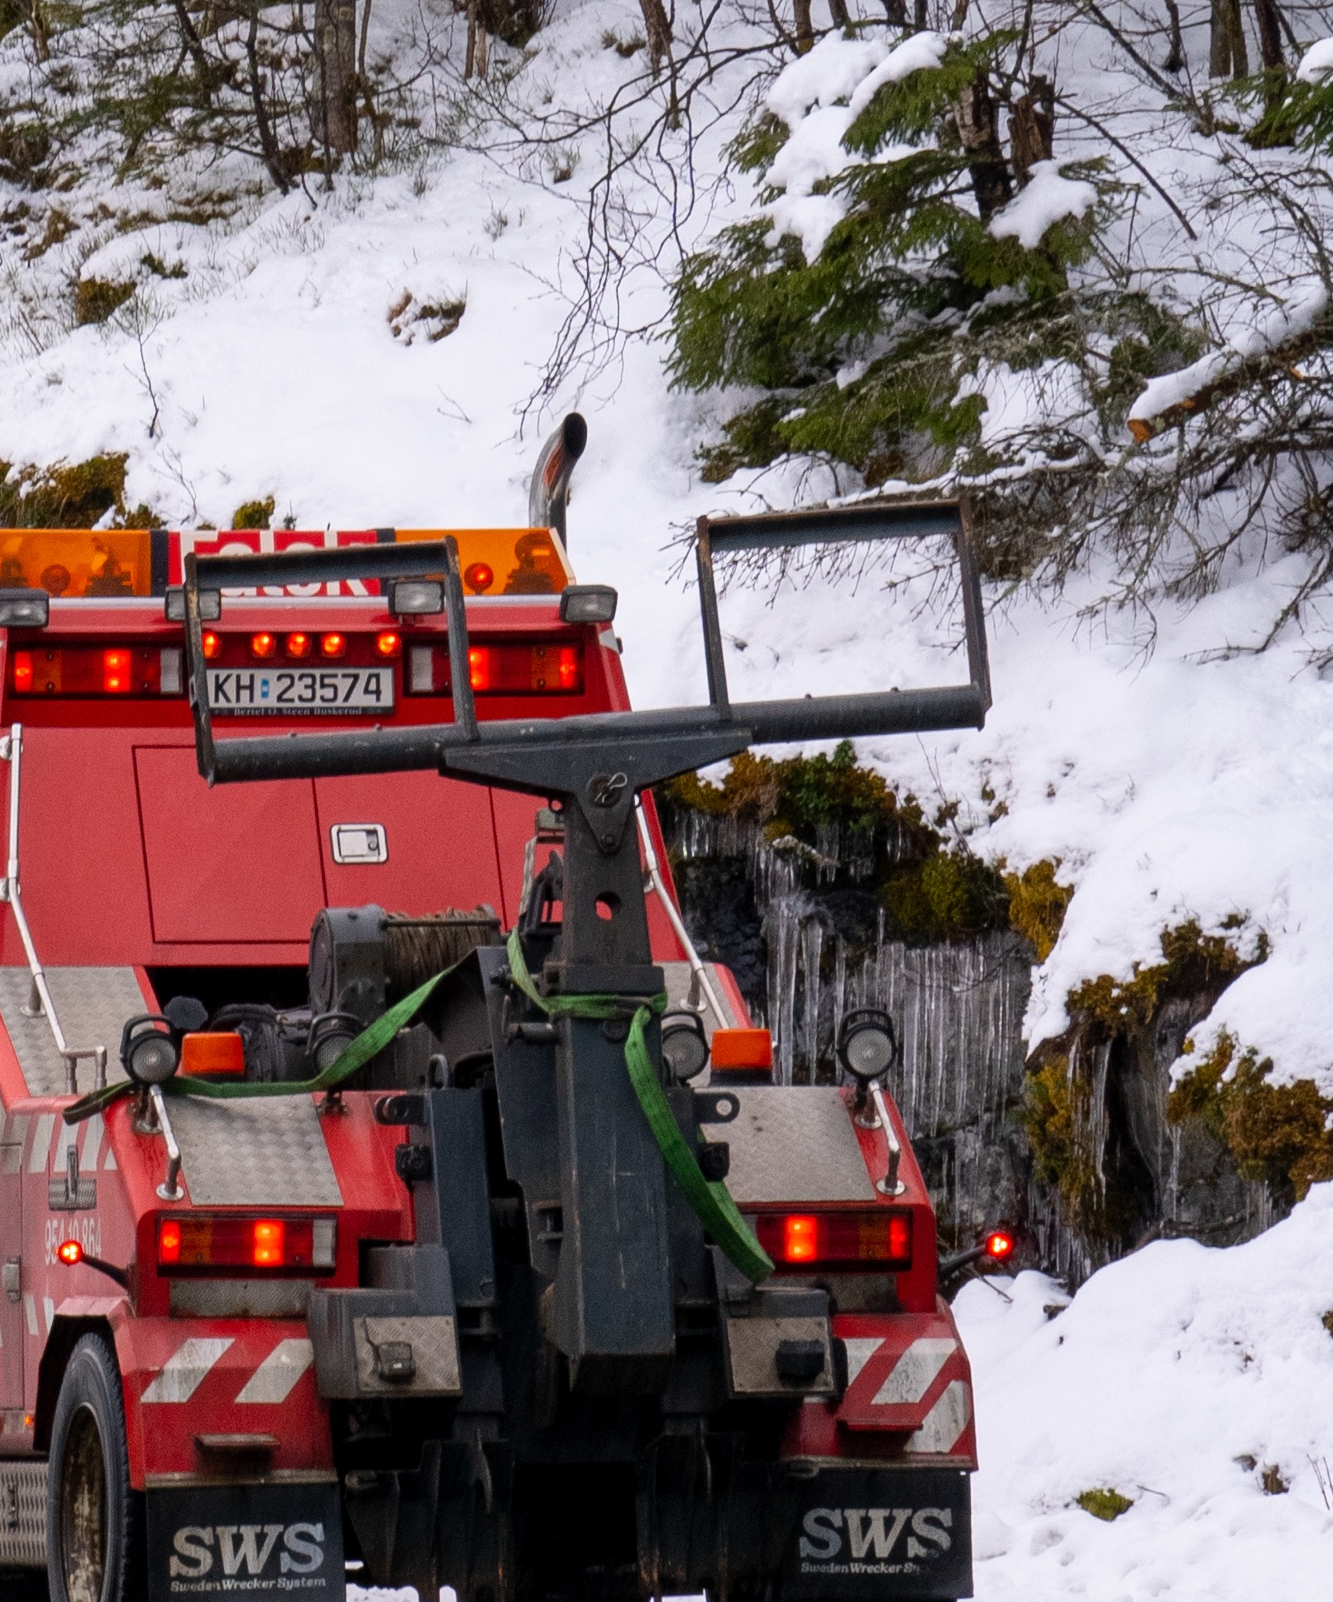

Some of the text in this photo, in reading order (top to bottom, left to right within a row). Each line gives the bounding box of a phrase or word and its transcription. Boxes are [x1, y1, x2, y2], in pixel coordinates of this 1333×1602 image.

[214, 673, 382, 704] KH 23574
[799, 1507, 953, 1559] SWS
[169, 1522, 325, 1578] SWS
[801, 1562, 849, 1575] Sweden
[849, 1562, 903, 1575] Wrecker
[170, 1576, 327, 1593] Sweden Wrecker System
